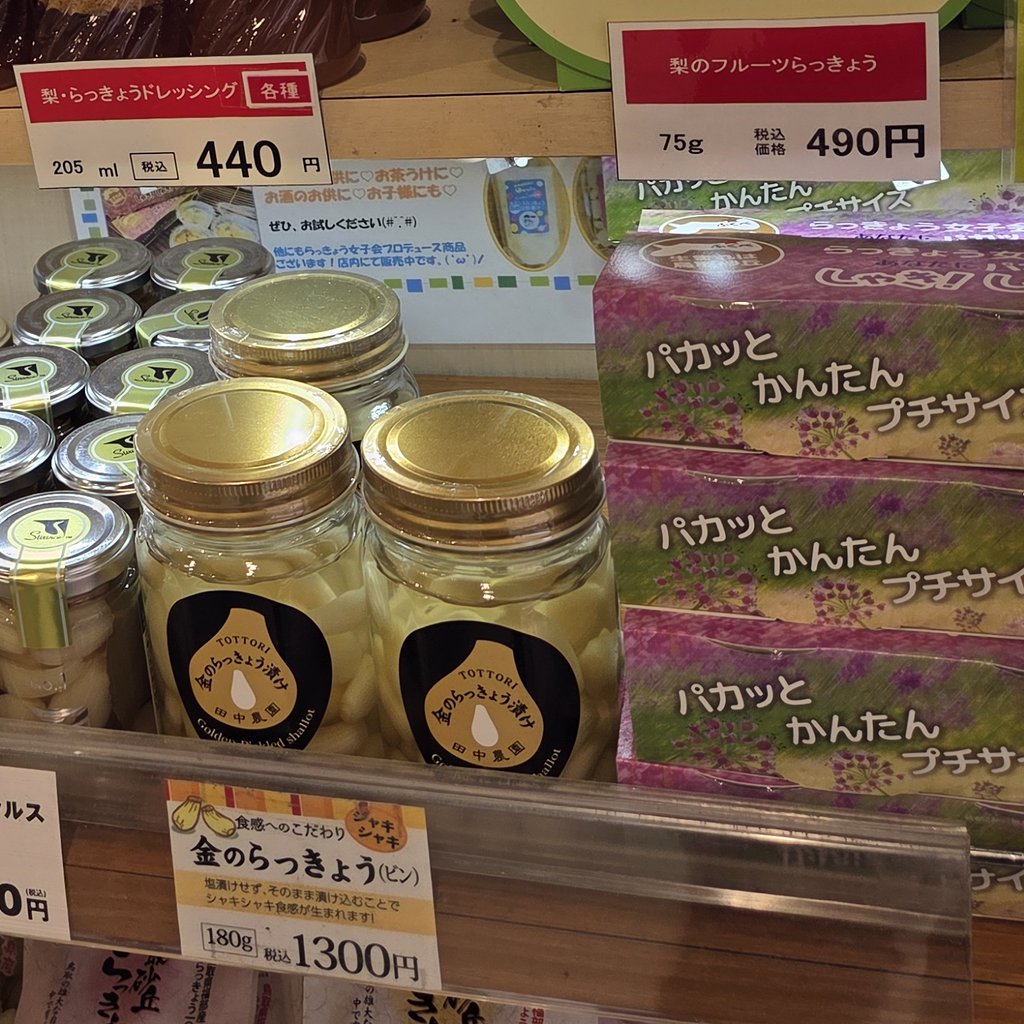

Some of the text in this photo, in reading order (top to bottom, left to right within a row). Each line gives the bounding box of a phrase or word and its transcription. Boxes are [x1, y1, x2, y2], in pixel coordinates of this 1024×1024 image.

[669, 53, 878, 76] 梨のフルーツらっきょう
[39, 80, 301, 105] 梨・らっきょうドレッシング 各種
[52, 139, 322, 179] 205 ml 税込 440 円
[658, 123, 926, 160] 75g 税込 490円
[754, 142, 788, 157] 価格
[375, 167, 449, 183] お茶うけに
[645, 330, 779, 379] パカッと
[751, 357, 905, 405] かんたん
[866, 387, 1024, 432] プチサイ
[660, 504, 795, 550] パカッと
[767, 533, 921, 577] かんたん
[215, 633, 272, 655] TOTTORI
[194, 649, 290, 693] 金のらっきょう漬け
[457, 667, 519, 691] TOTTORI
[431, 683, 536, 729] 金のらっきょう漬け
[677, 675, 814, 716] パカッと
[786, 707, 941, 747] かんたん
[901, 745, 1024, 775] プチサ
[235, 814, 347, 843] 食感へのこだわり
[357, 825, 401, 850] シャキ
[188, 835, 421, 888] 金のらっきょう (ビン)
[203, 875, 401, 914] 塩漬けせず、そのまま漬け込むことで
[204, 924, 421, 982] 180g 税込 1300円
